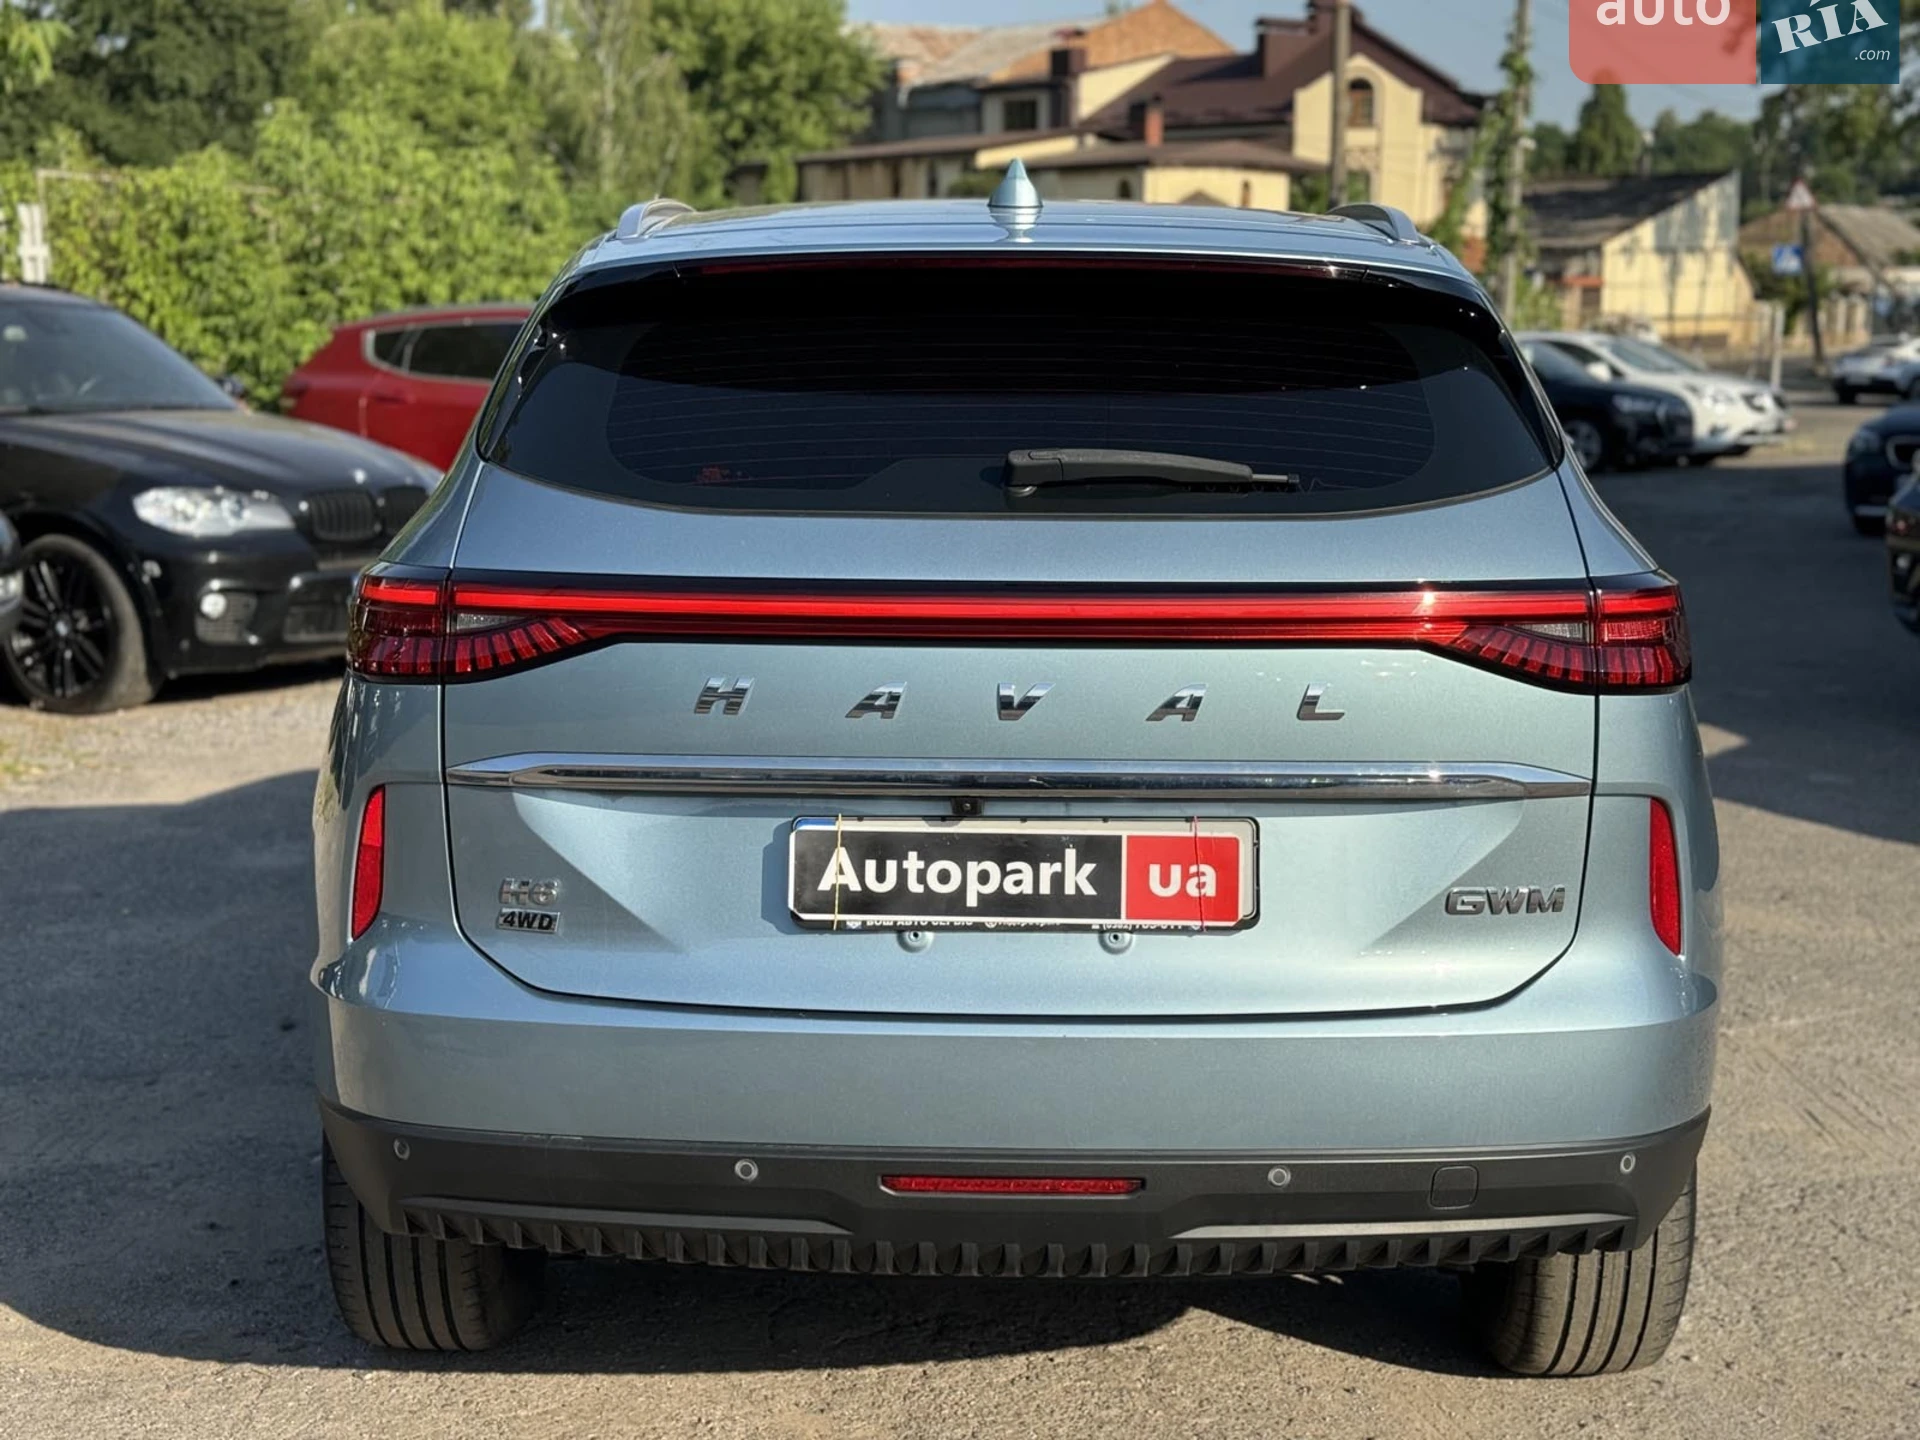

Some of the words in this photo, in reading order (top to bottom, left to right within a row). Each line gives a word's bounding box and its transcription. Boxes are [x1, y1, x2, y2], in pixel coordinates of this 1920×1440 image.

[694, 676, 1345, 721] HAVAL
[499, 877, 558, 906] H6
[817, 846, 1098, 907] Autopark
[1149, 863, 1217, 897] ua
[1445, 884, 1566, 915] GWM
[502, 911, 554, 931] 4WD
